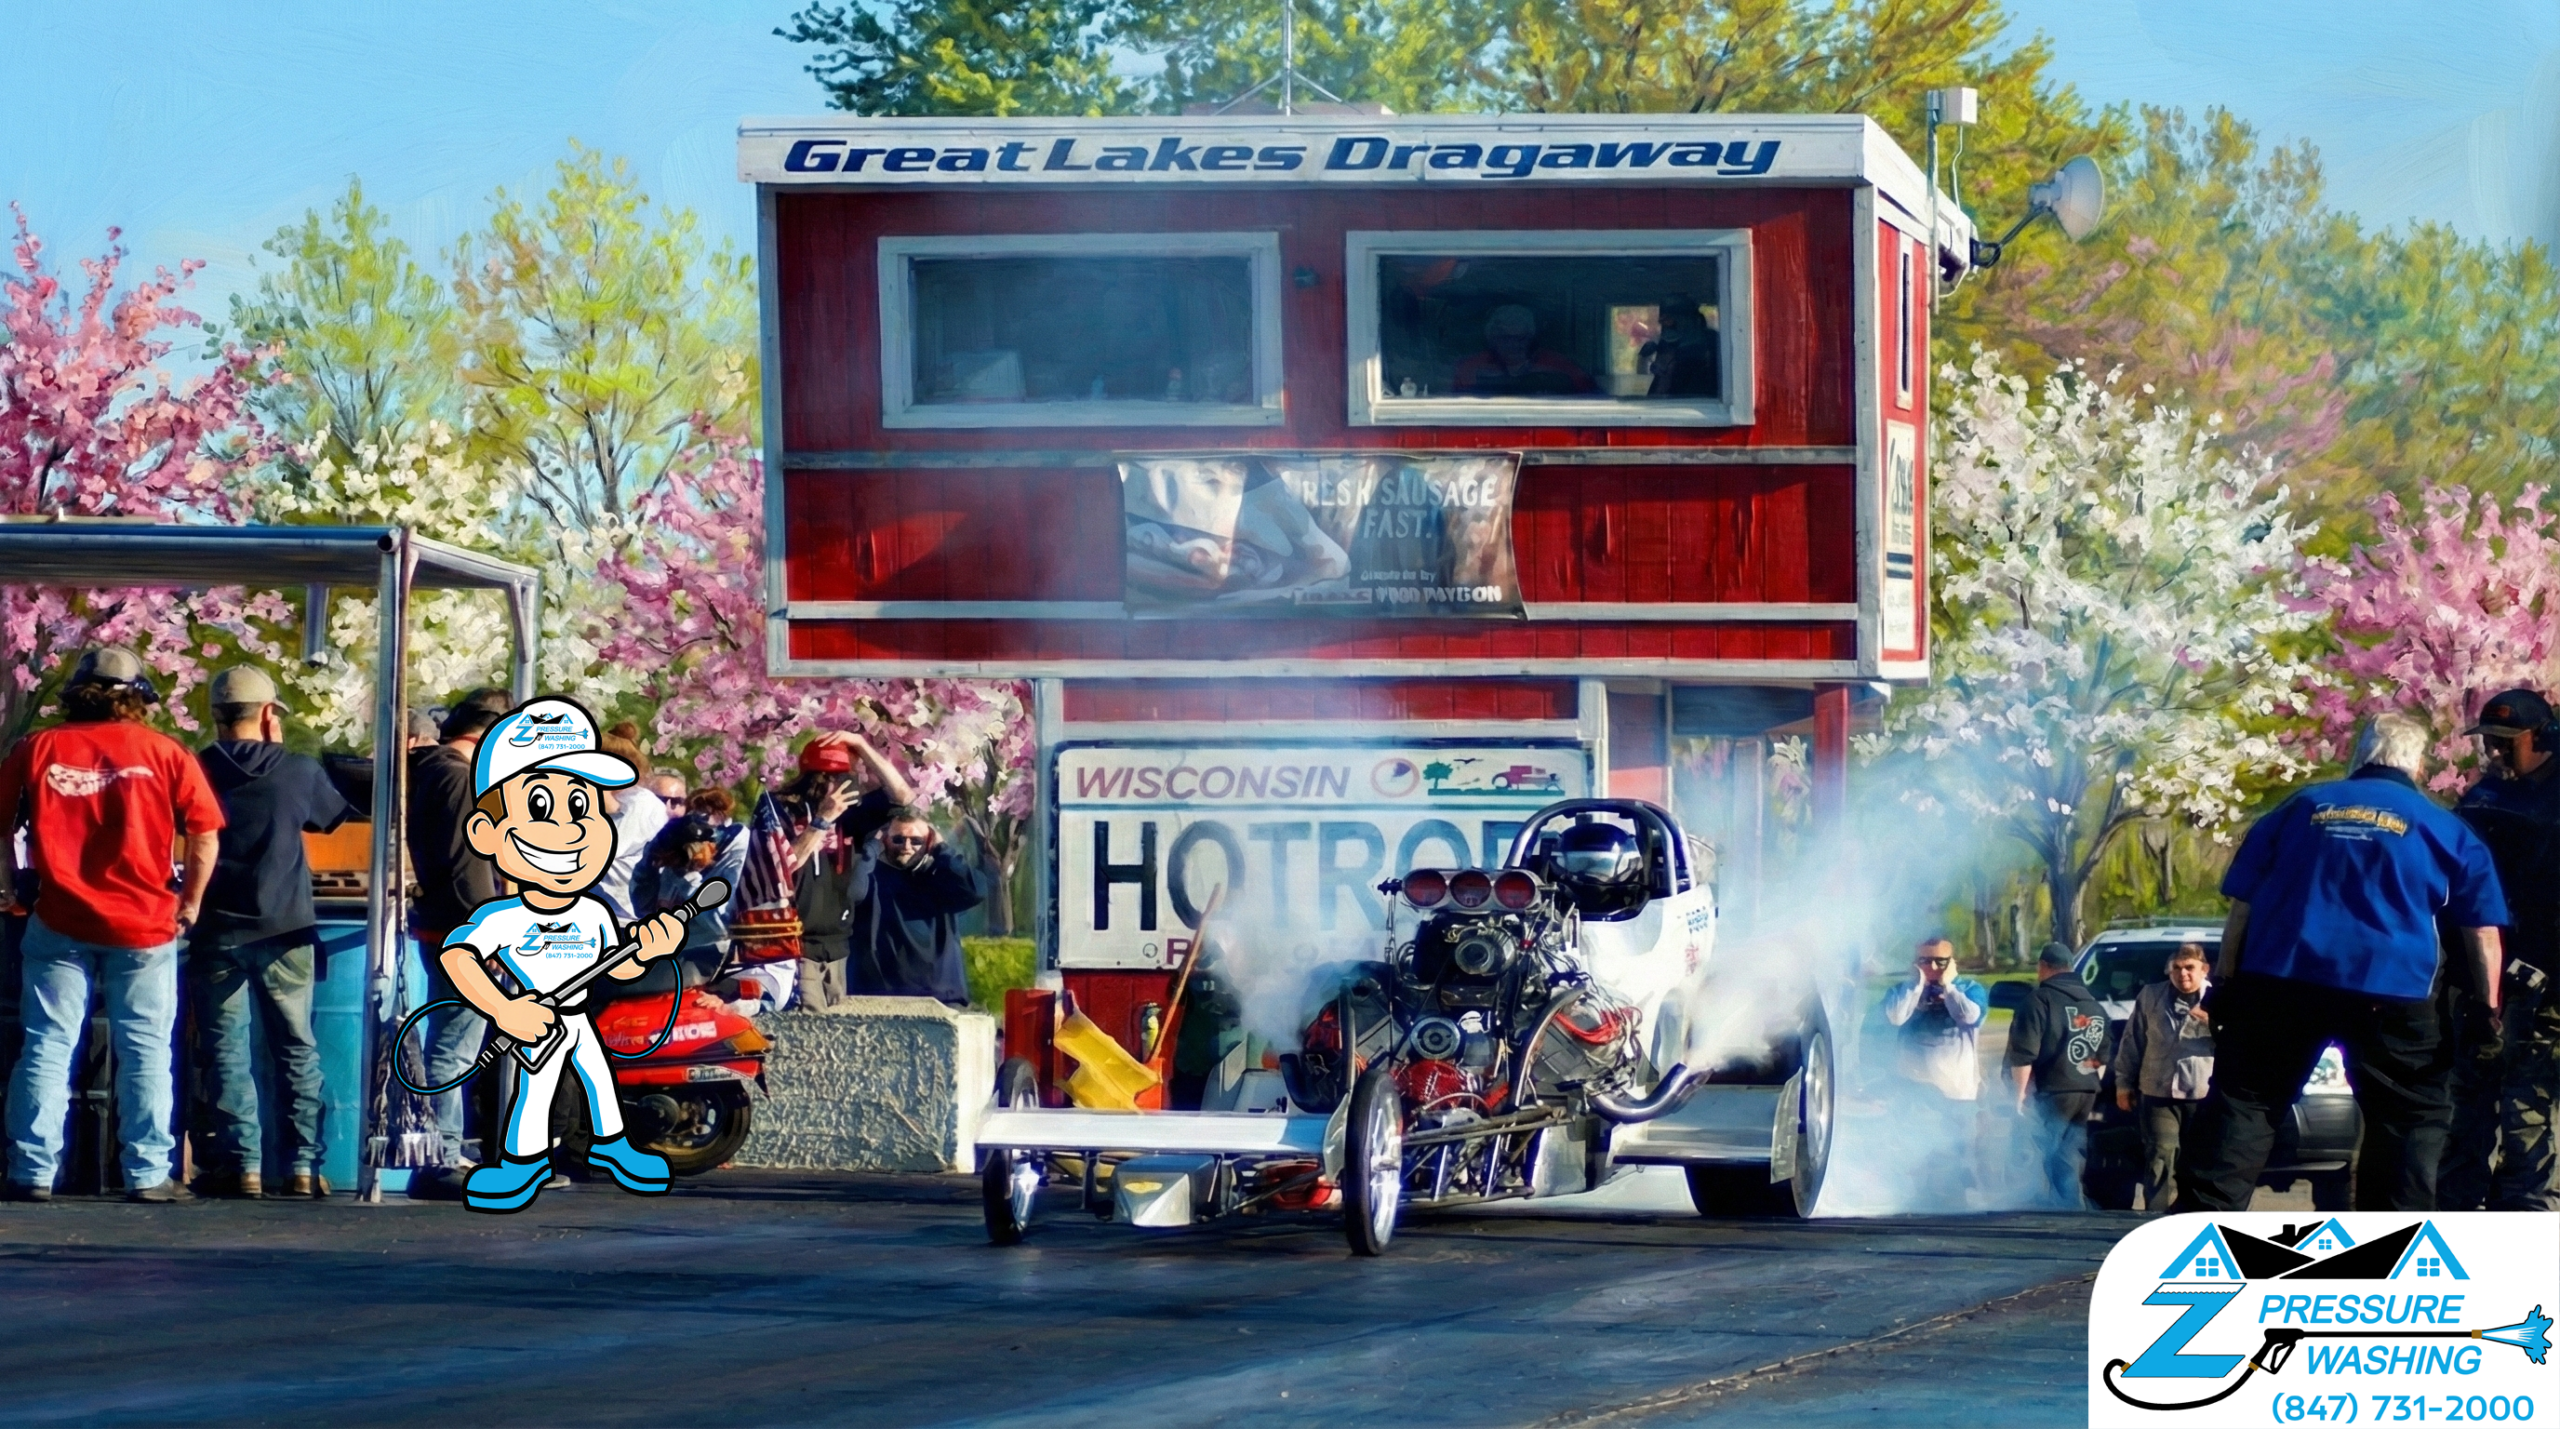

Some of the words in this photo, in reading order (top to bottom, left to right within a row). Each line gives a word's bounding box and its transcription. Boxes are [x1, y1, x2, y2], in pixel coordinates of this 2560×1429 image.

[783, 139, 1037, 173] Great
[1042, 137, 1307, 172] Lakes
[1324, 136, 1782, 178] Dragaway
[1380, 475, 1499, 507] SAUSAGE
[1363, 508, 1432, 539] FAST.
[1076, 765, 1351, 798] WISCONSIN
